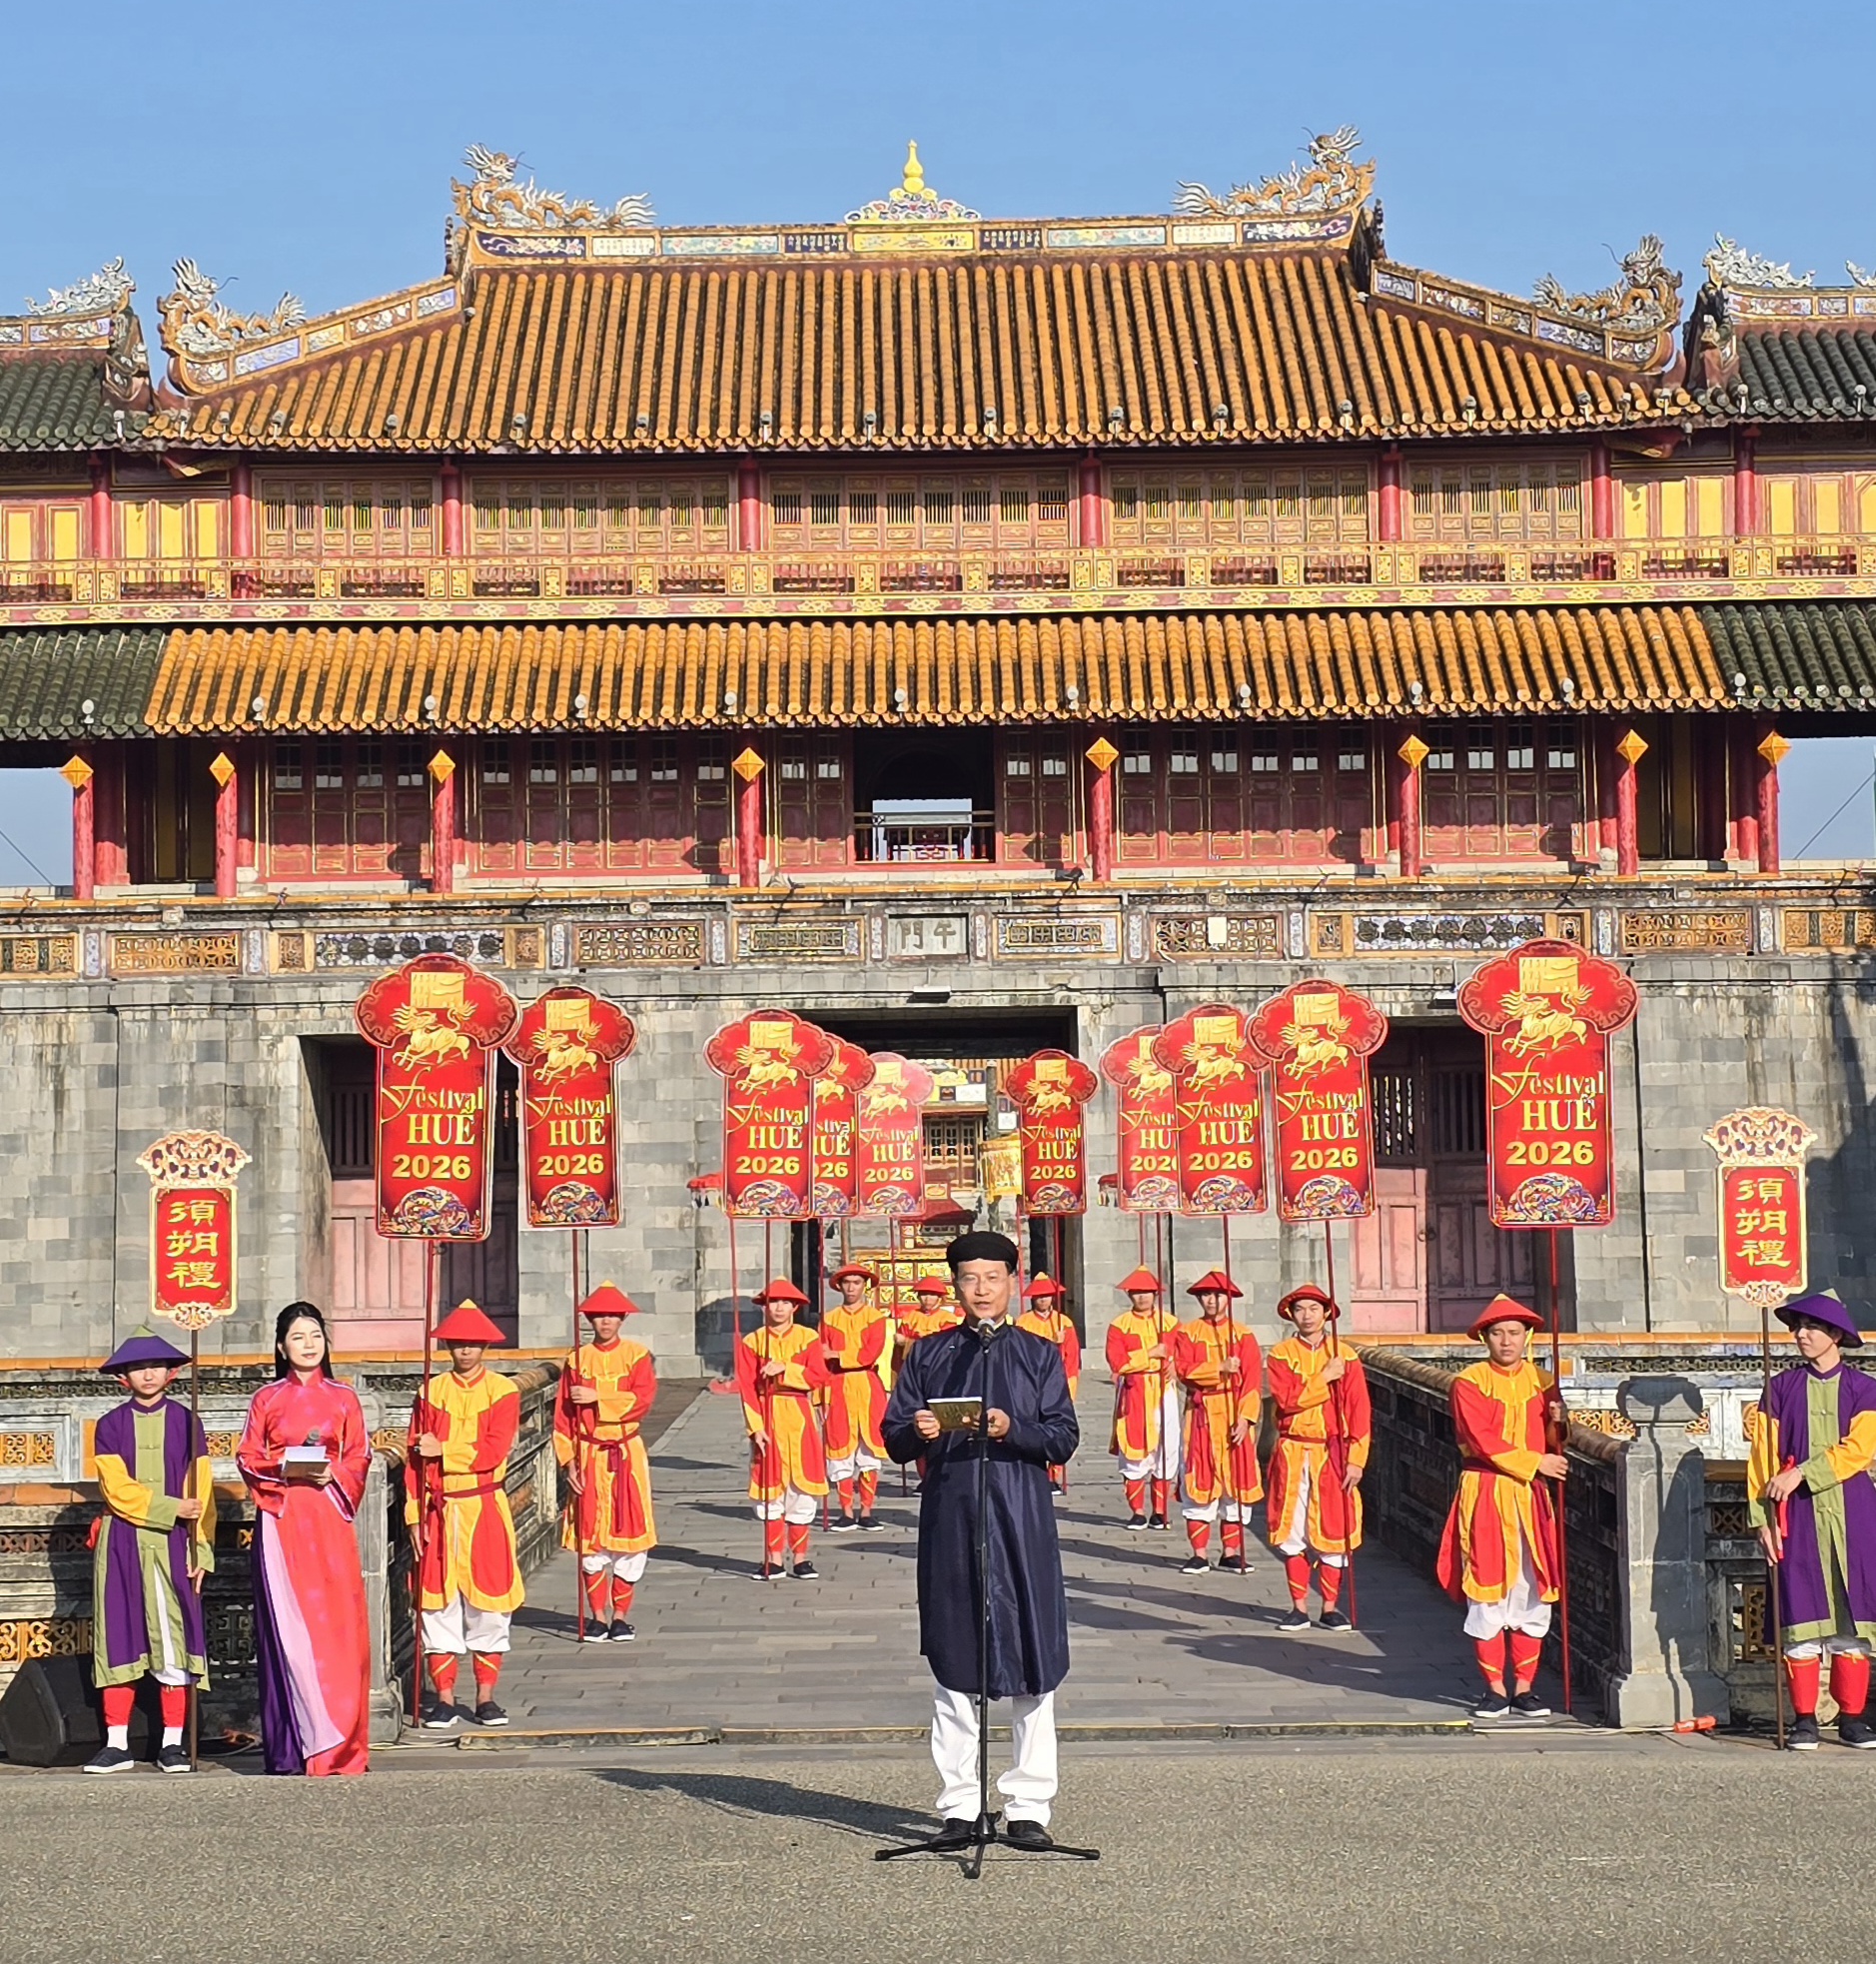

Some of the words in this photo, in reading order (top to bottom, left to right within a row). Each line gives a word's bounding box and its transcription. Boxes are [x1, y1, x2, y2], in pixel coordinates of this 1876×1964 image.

[1491, 1052, 1604, 1111] Festival
[381, 1066, 484, 1124] Festival
[1276, 1074, 1364, 1126] Festival
[816, 1116, 855, 1133] stival
[1120, 1098, 1176, 1135] Festi
[1140, 1129, 1177, 1149] HU
[1189, 1151, 1253, 1171] 2026
[1290, 1147, 1359, 1171] 2026
[1505, 1141, 1594, 1165] 2026
[392, 1154, 471, 1180] 2026
[537, 1154, 604, 1176] 2026
[735, 1156, 800, 1176] 2026
[814, 1162, 848, 1178] 26
[864, 1166, 914, 1183] 2026
[1030, 1165, 1077, 1180] 2026
